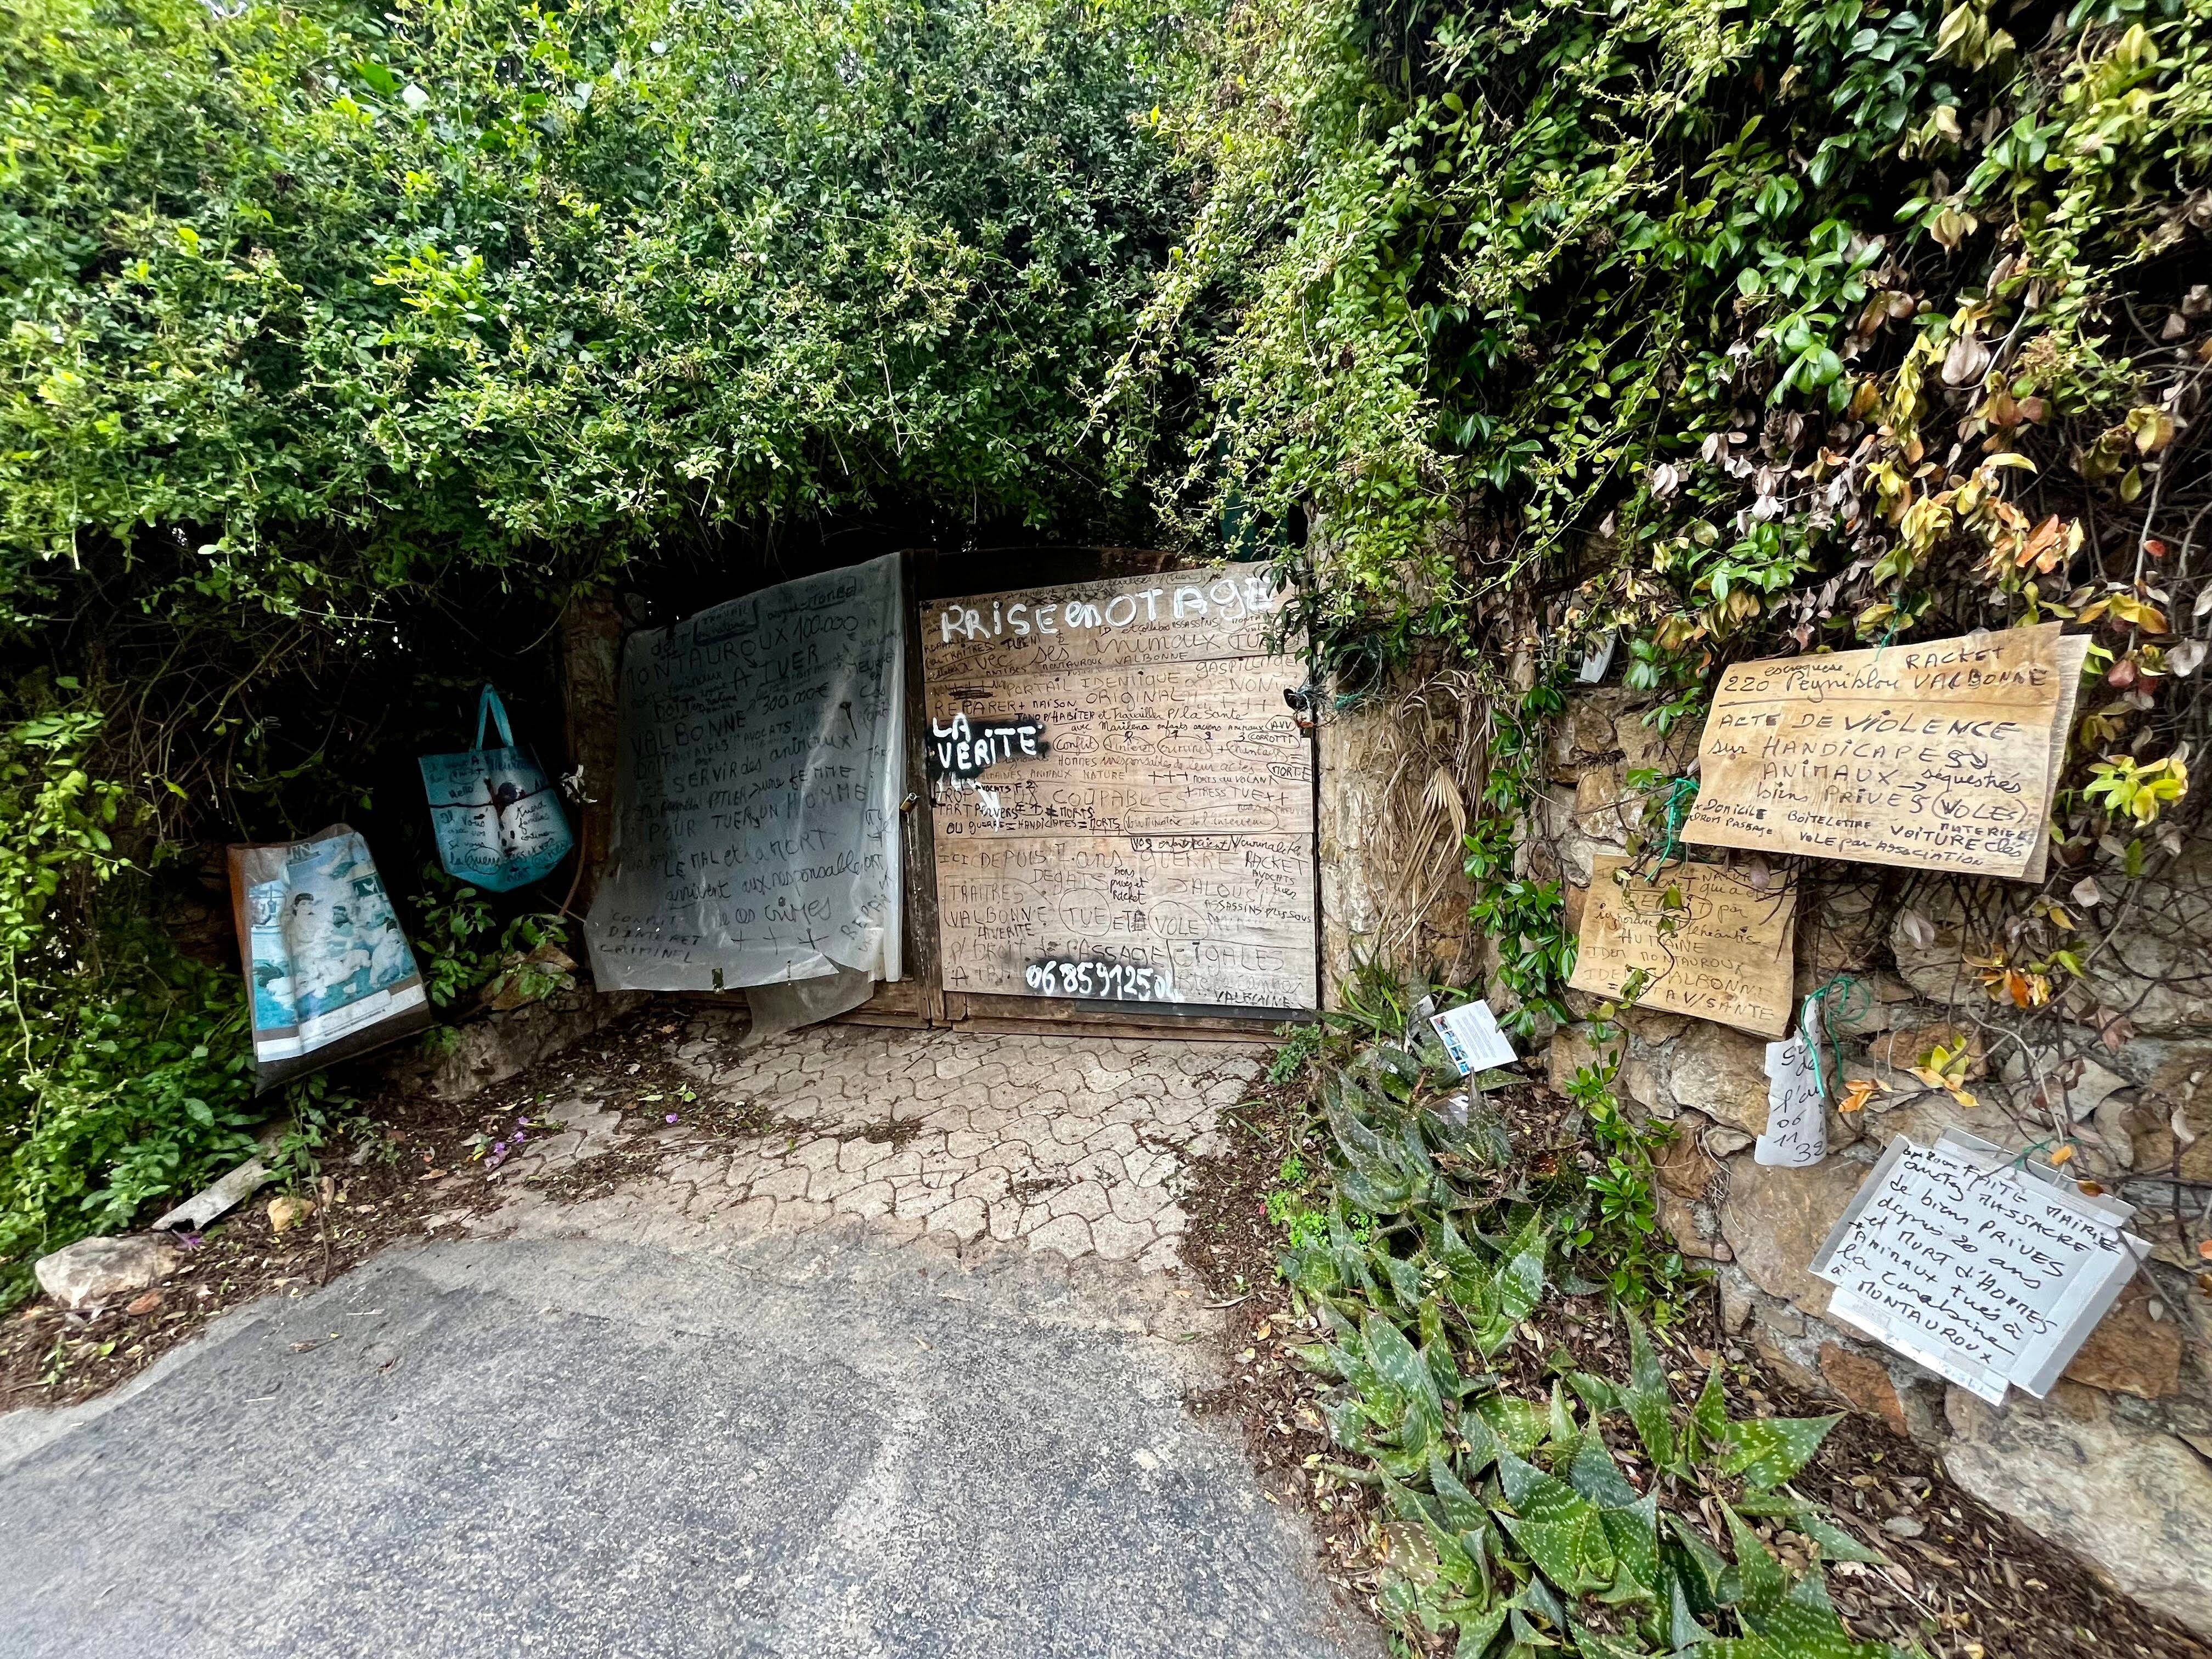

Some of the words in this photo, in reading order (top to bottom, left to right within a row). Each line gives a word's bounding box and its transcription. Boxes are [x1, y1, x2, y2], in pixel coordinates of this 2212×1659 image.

[1724, 675, 1770, 692] 220
[933, 713, 971, 741] LA
[1719, 713, 1781, 729] ACTE
[1791, 713, 1833, 729] DE
[649, 819, 697, 843] POUR
[664, 860, 686, 880] LE
[1155, 917, 1200, 936] VOLE
